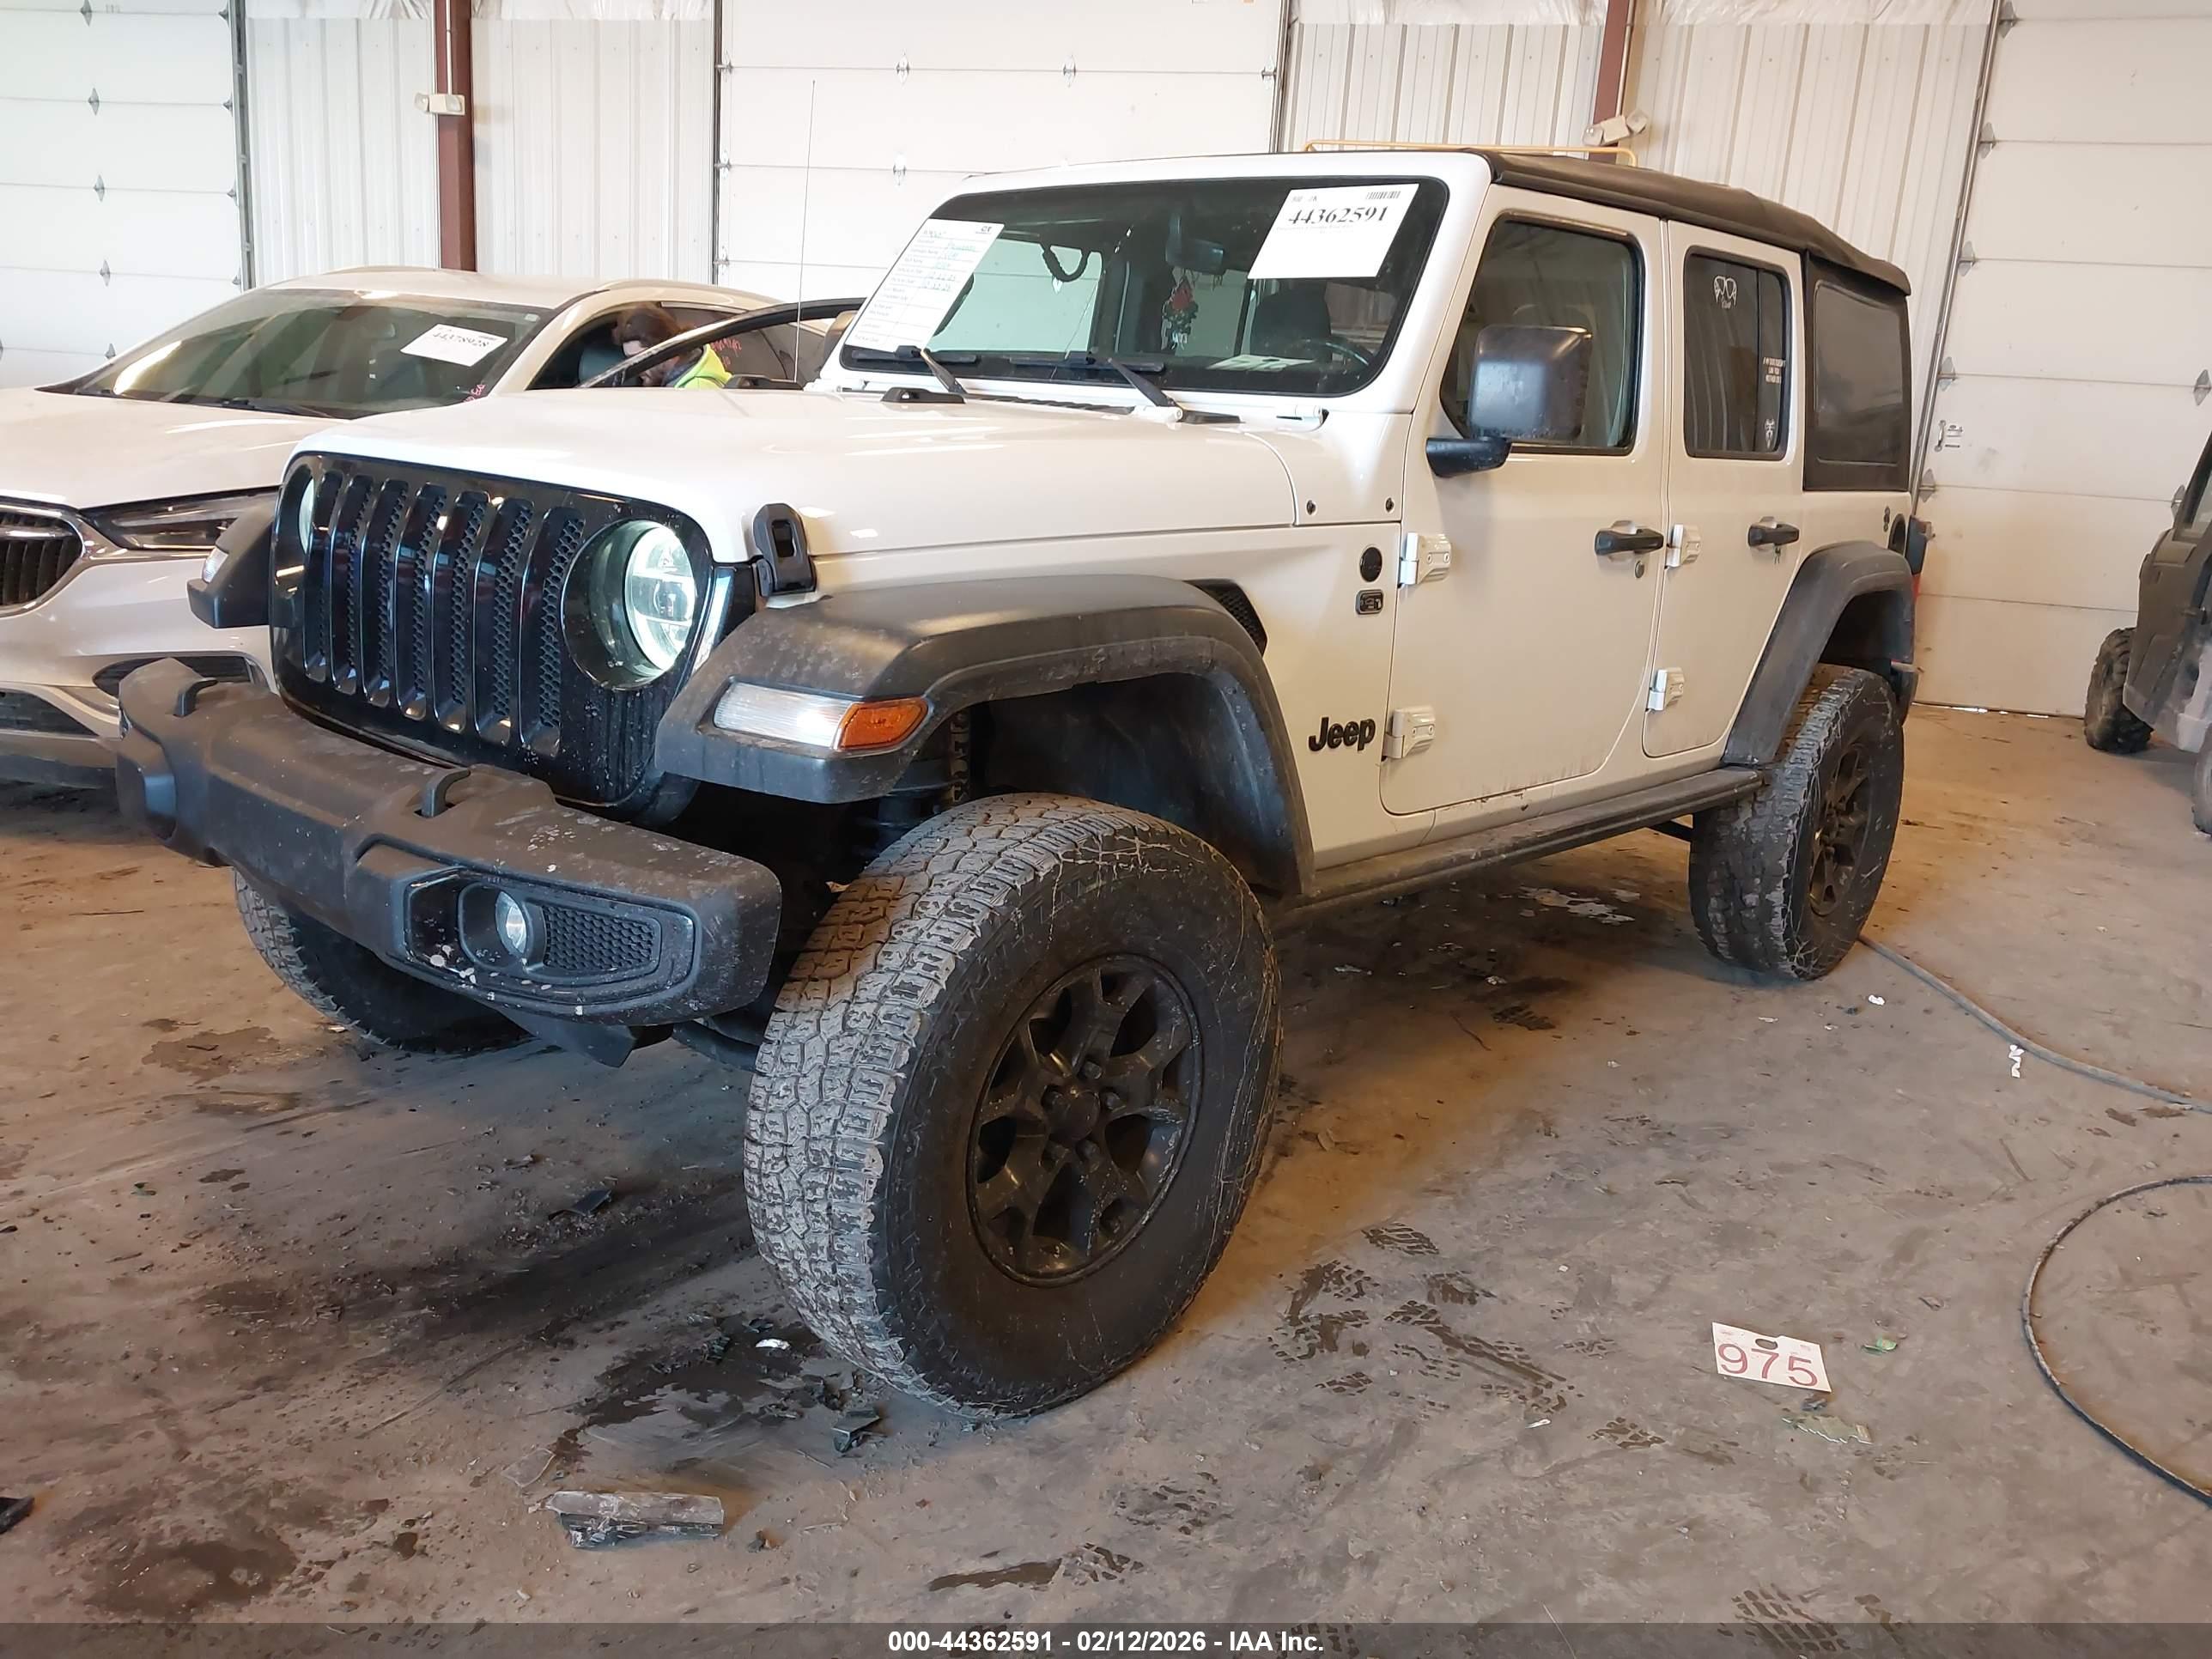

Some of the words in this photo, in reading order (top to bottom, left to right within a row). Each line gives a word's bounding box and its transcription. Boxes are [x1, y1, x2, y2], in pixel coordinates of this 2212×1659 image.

[1288, 205, 1389, 225] 44362591
[1308, 717, 1376, 752] Jeep
[1717, 1343, 1818, 1387] 975
